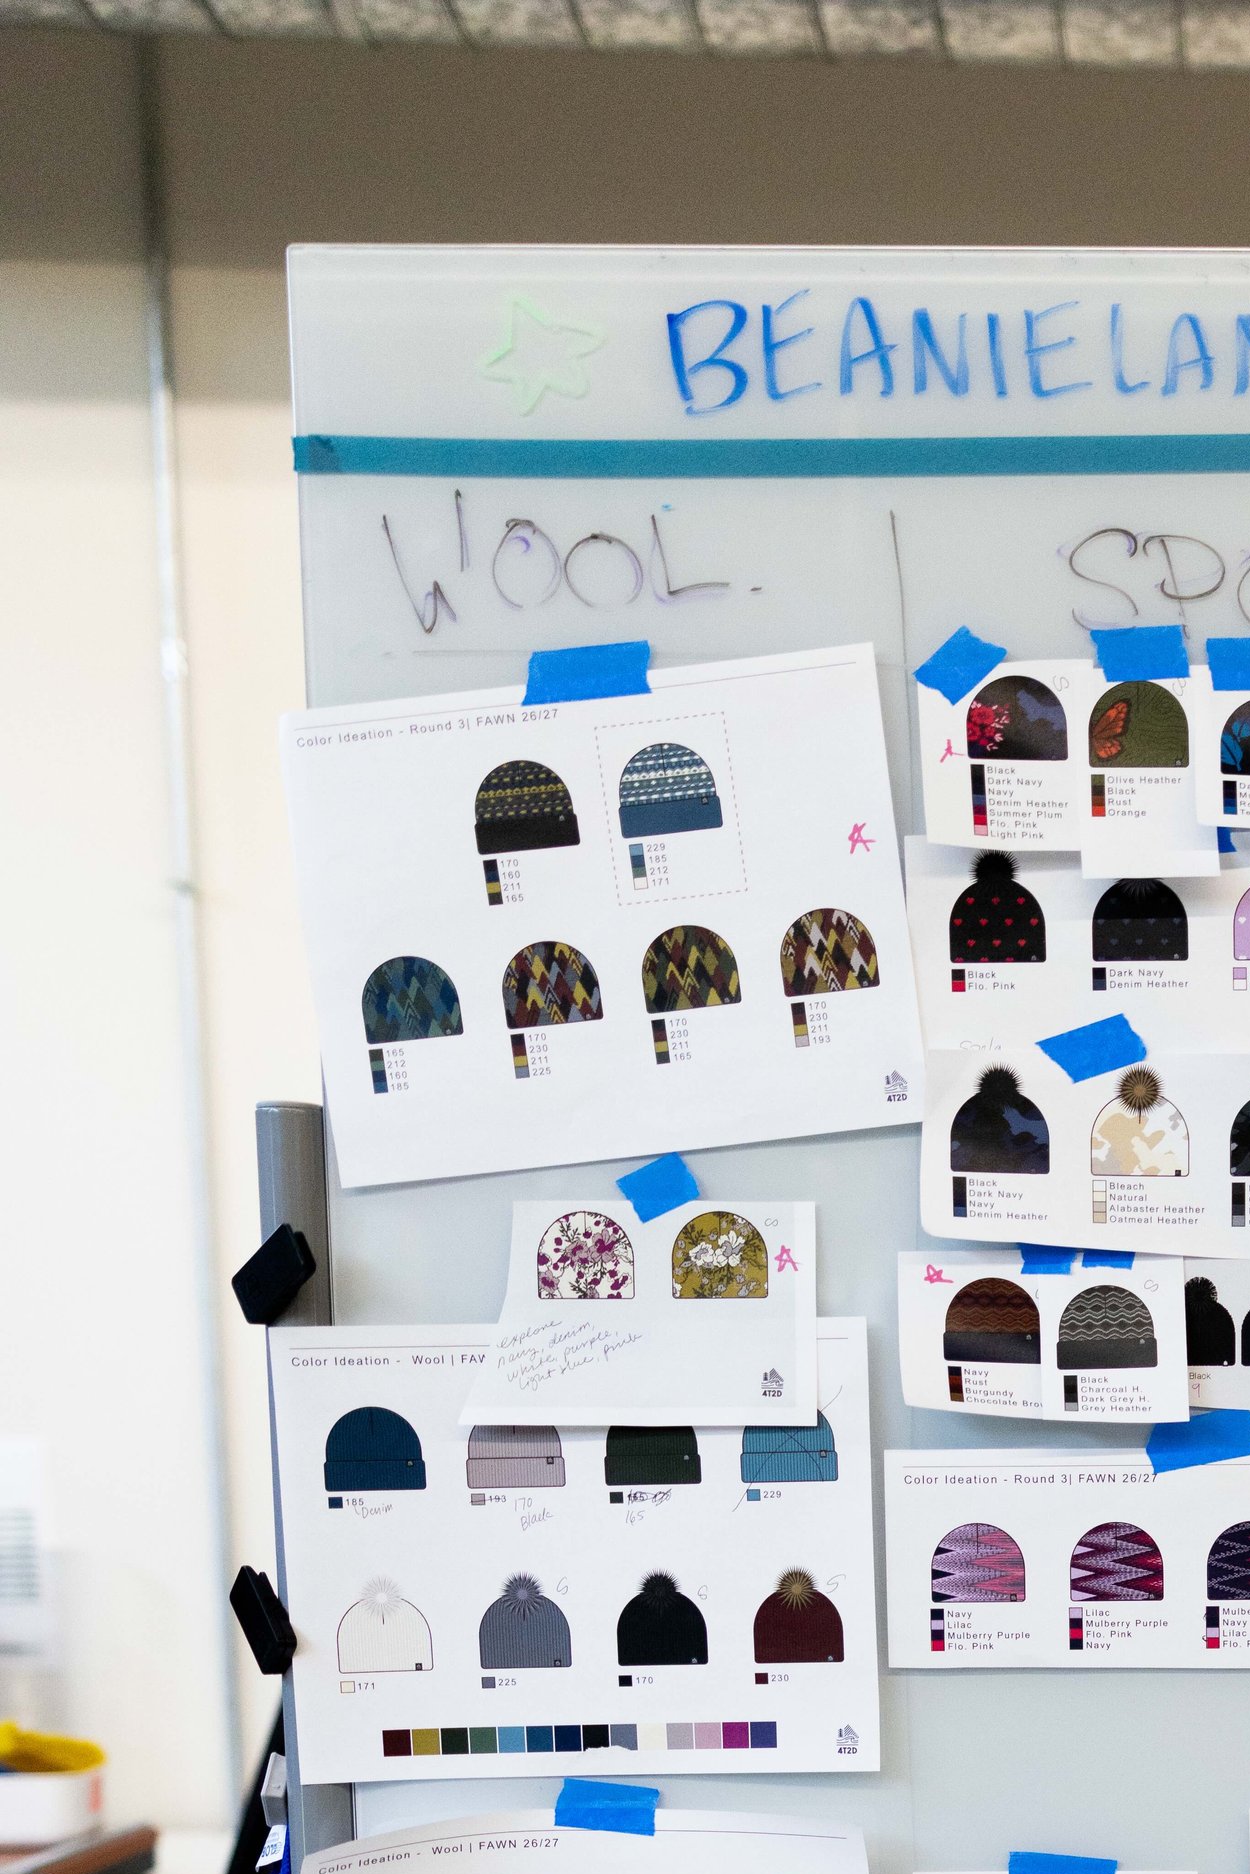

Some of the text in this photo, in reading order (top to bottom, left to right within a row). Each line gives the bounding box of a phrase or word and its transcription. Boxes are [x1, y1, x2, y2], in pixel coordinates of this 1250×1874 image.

[296, 735, 332, 748] Color
[338, 729, 393, 743] Ideation
[409, 720, 452, 735] Round
[476, 713, 516, 727] FAWN
[521, 708, 558, 723] 26/27
[1106, 775, 1182, 785] Olive Heather
[1107, 786, 1137, 796] Black
[1107, 797, 1132, 807] Rust
[1107, 808, 1147, 820] Orange
[646, 842, 666, 853] 229
[648, 853, 667, 864] 185
[649, 865, 669, 876] 212
[651, 877, 670, 887] 171
[992, 981, 1016, 990] Pink
[808, 1000, 827, 1011] 170
[808, 1012, 828, 1023] 230
[807, 1023, 828, 1035] 211
[812, 1034, 831, 1045] 193
[886, 1093, 908, 1103] 4T2D
[1188, 1371, 1211, 1381] Black
[903, 1474, 939, 1485] Color
[944, 1474, 998, 1485] Ideation
[1014, 1474, 1055, 1484] Round
[1078, 1473, 1116, 1484] FAWN
[1122, 1471, 1161, 1484] 26/27
[763, 1490, 782, 1499] 229
[1085, 1619, 1169, 1633] Mulberry Purple
[770, 1673, 790, 1683] 230
[357, 1682, 375, 1691] 171
[358, 1850, 411, 1868] Ideation
[431, 1843, 463, 1855] Wool
[478, 1839, 517, 1851] FAWN
[523, 1838, 559, 1849] 26/27
